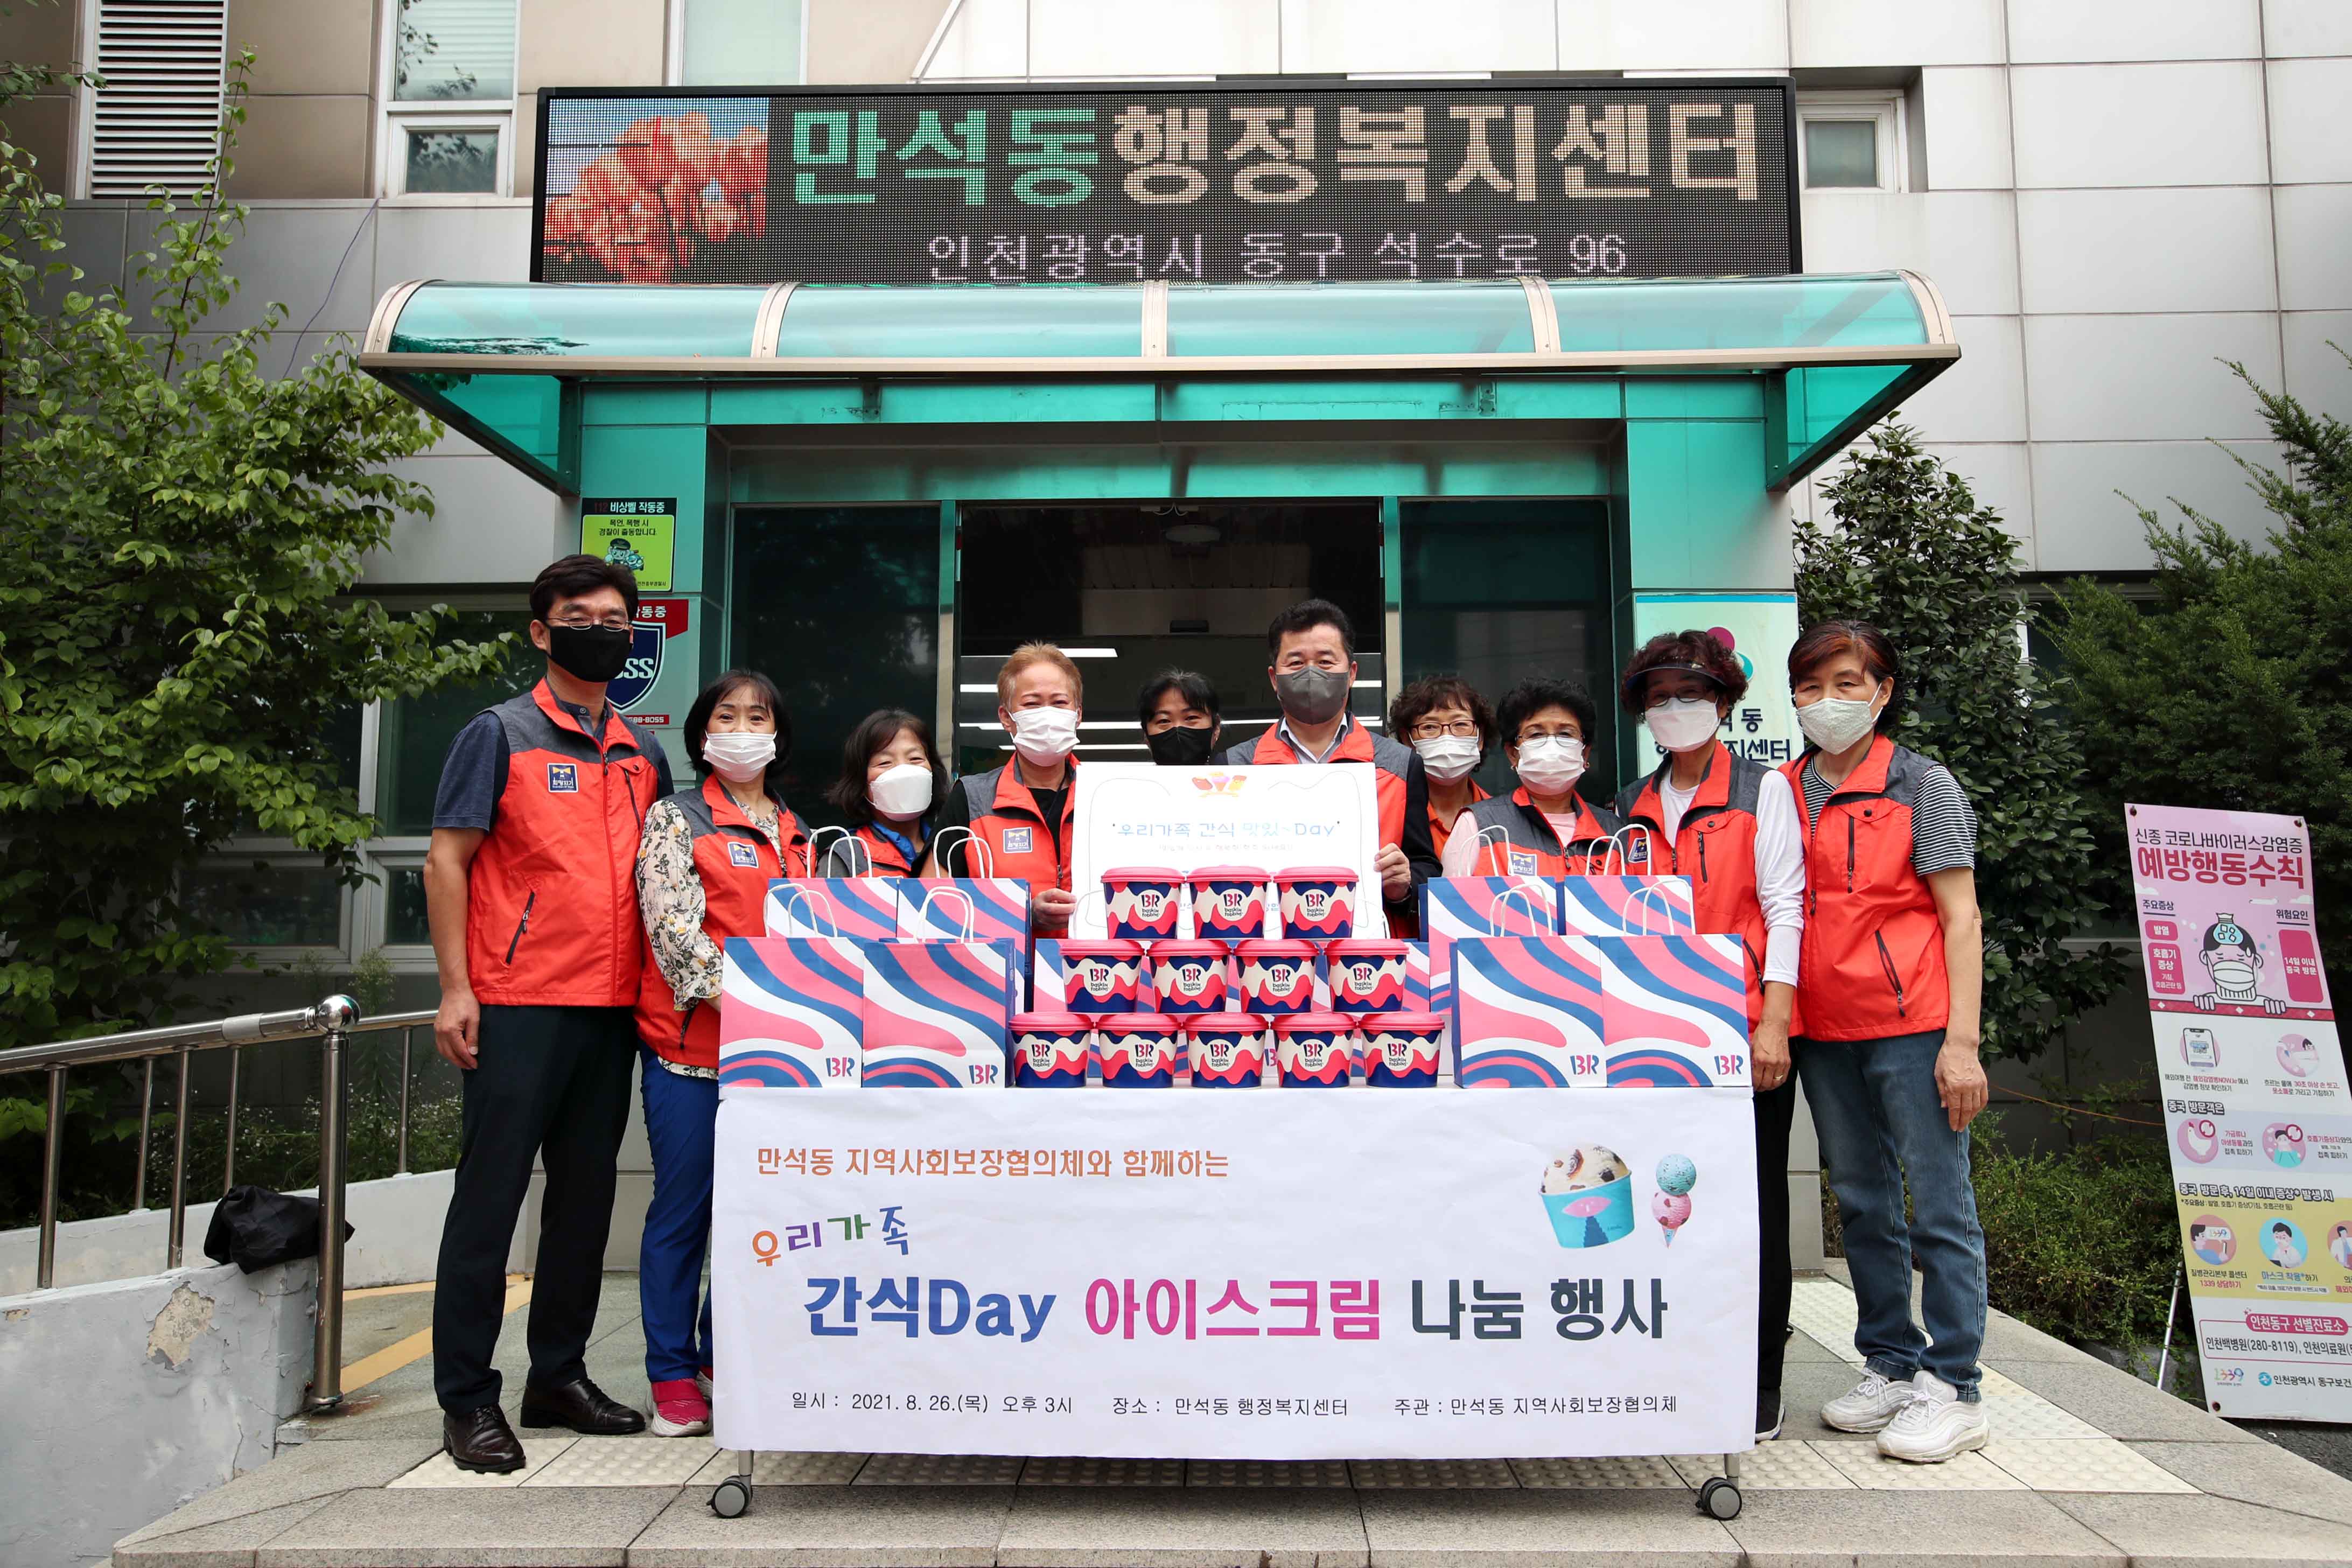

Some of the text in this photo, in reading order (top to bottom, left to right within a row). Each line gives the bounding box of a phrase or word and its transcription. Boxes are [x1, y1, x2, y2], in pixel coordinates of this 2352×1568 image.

[928, 230, 1628, 282] 인천광역시 동구 석수로 96
[610, 501, 636, 513] 비상벨
[639, 501, 664, 513] 작동중
[1199, 823, 1234, 837] 간식
[2136, 828, 2302, 853] 신종 코로나바이러스감염증
[2138, 847, 2304, 889] 예방행동수칙
[1142, 894, 1160, 907] BR
[1223, 894, 1242, 906] BR
[1306, 894, 1325, 907] BR
[2143, 899, 2174, 911] 주요증상
[2276, 909, 2308, 920] 위험요인
[2154, 926, 2169, 936] 발열
[2153, 948, 2176, 959] 호흡기
[2158, 960, 2174, 970] 증상
[2284, 957, 2300, 965] 14일
[1090, 969, 1109, 981] BR
[1182, 969, 1201, 981] BR
[1272, 969, 1291, 982] BR
[1353, 968, 1372, 980] BR
[1032, 1044, 1050, 1057] BR
[1135, 1044, 1153, 1057] BR
[1210, 1044, 1229, 1057] BR
[1304, 1044, 1322, 1057] BR
[1388, 1044, 1406, 1056] BR
[825, 1057, 855, 1077] BR
[1570, 1054, 1599, 1075] BR
[1714, 1054, 1744, 1075] BR
[969, 1065, 998, 1084] BR
[2168, 1100, 2225, 1115] 중국 방문객은
[759, 1149, 1228, 1177] 만석동 지역사회보장협의체와 함께하는
[2179, 1183, 2197, 1196] 중국
[2200, 1184, 2219, 1197] 방문
[2234, 1186, 2255, 1199] 14일
[2256, 1186, 2275, 1199] 이내
[2301, 1188, 2321, 1201] 발생
[2323, 1189, 2334, 1202] 시
[752, 1206, 909, 1267] 우리가족
[2262, 1271, 2284, 1280] 마스크
[2217, 1280, 2241, 1289] 상담하기
[804, 1277, 1668, 1343] 간식Day 아이스크림 나눔 행사
[2250, 1315, 2344, 1333] 인천동구 선별진료소
[2273, 1375, 2315, 1387] 인천광역시
[792, 1392, 825, 1409] 일시
[852, 1394, 899, 1410] 2021.
[906, 1395, 921, 1410] 8.
[929, 1394, 988, 1413] 26.(목)
[1003, 1396, 1037, 1413] 오후
[1045, 1397, 1071, 1413] 3시
[1113, 1398, 1147, 1415] 장소
[1175, 1398, 1229, 1415] 만석동
[1238, 1398, 1347, 1416] 행정복지센터
[1395, 1399, 1430, 1416] 주관
[1451, 1398, 1504, 1415] 만석동
[1514, 1396, 1676, 1415] 지역사회보장협의체
